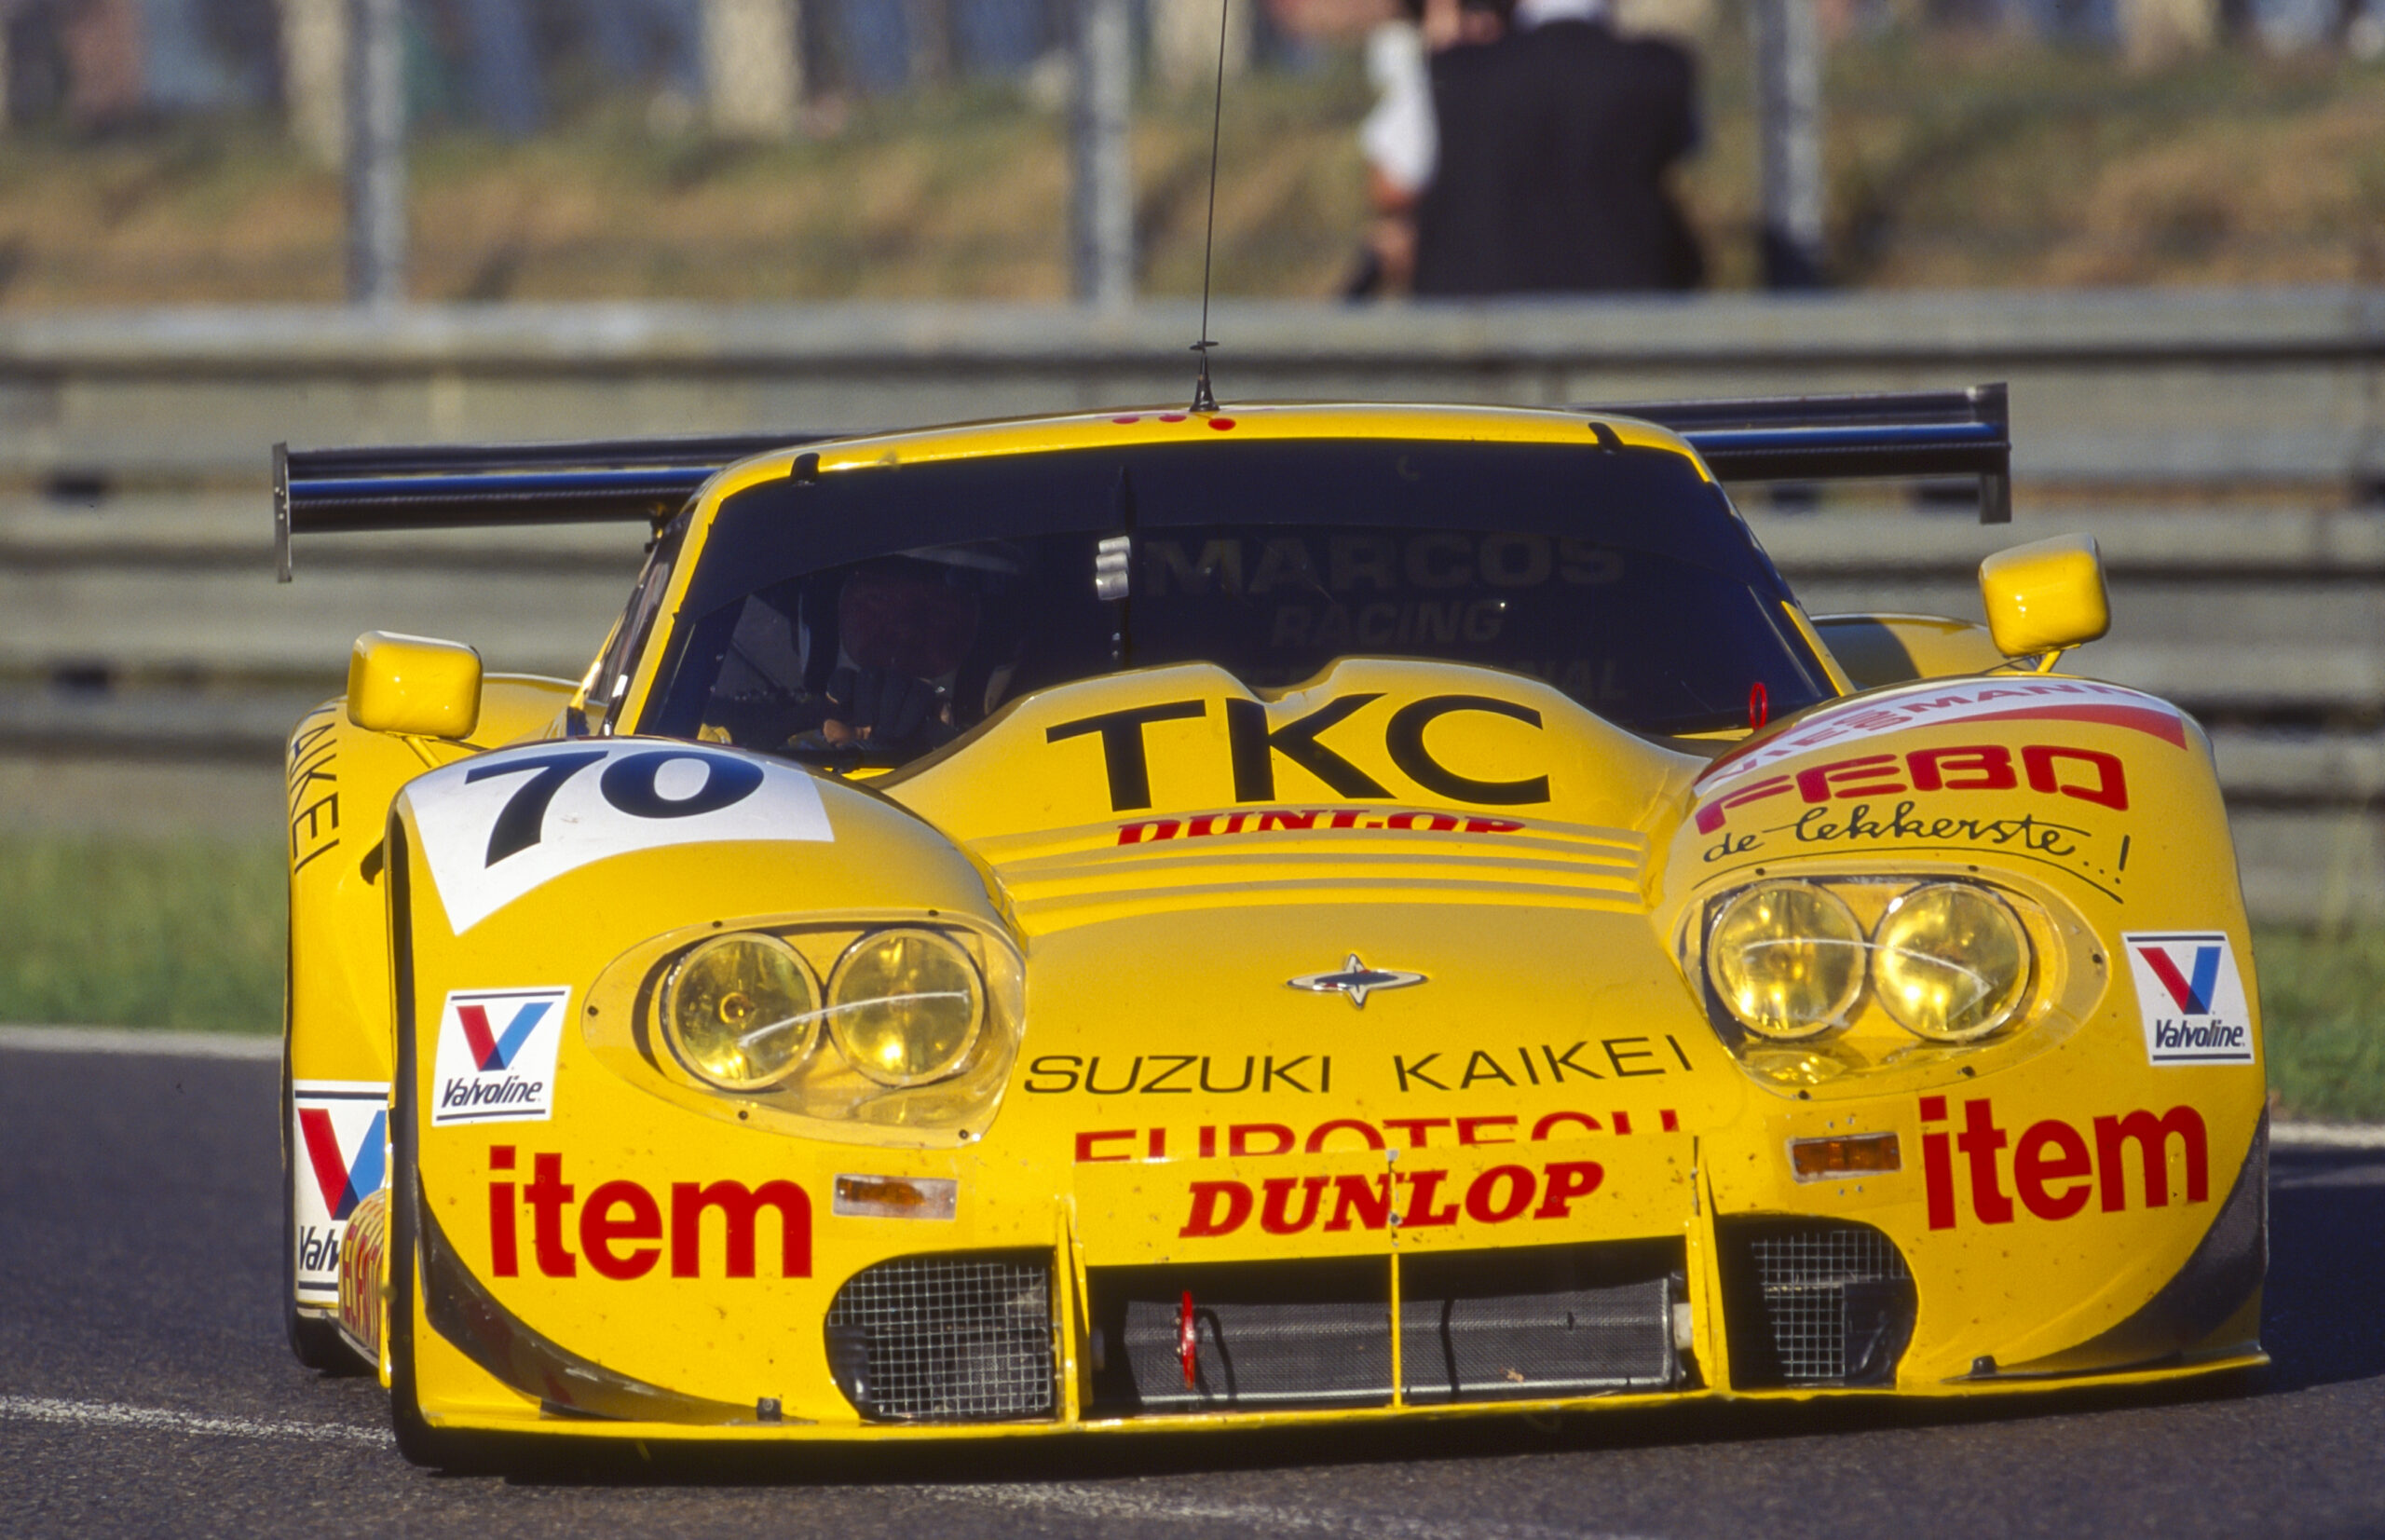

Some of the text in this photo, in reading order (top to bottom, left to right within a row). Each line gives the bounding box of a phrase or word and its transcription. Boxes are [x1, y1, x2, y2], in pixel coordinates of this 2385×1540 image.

[1143, 532, 1626, 597] MARCOS
[1271, 599, 1507, 649] RACING
[1045, 692, 1551, 812] TKC
[464, 749, 765, 869] 70
[1703, 831, 1765, 863] de
[1024, 1033, 1694, 1096] SUZUKI KAIKEI
[2155, 1018, 2244, 1049] Valvoline
[441, 1075, 543, 1109] Valvoline
[1919, 1095, 2210, 1232] item
[489, 1145, 813, 1281] item
[1179, 1160, 1604, 1239] DUNLOP
